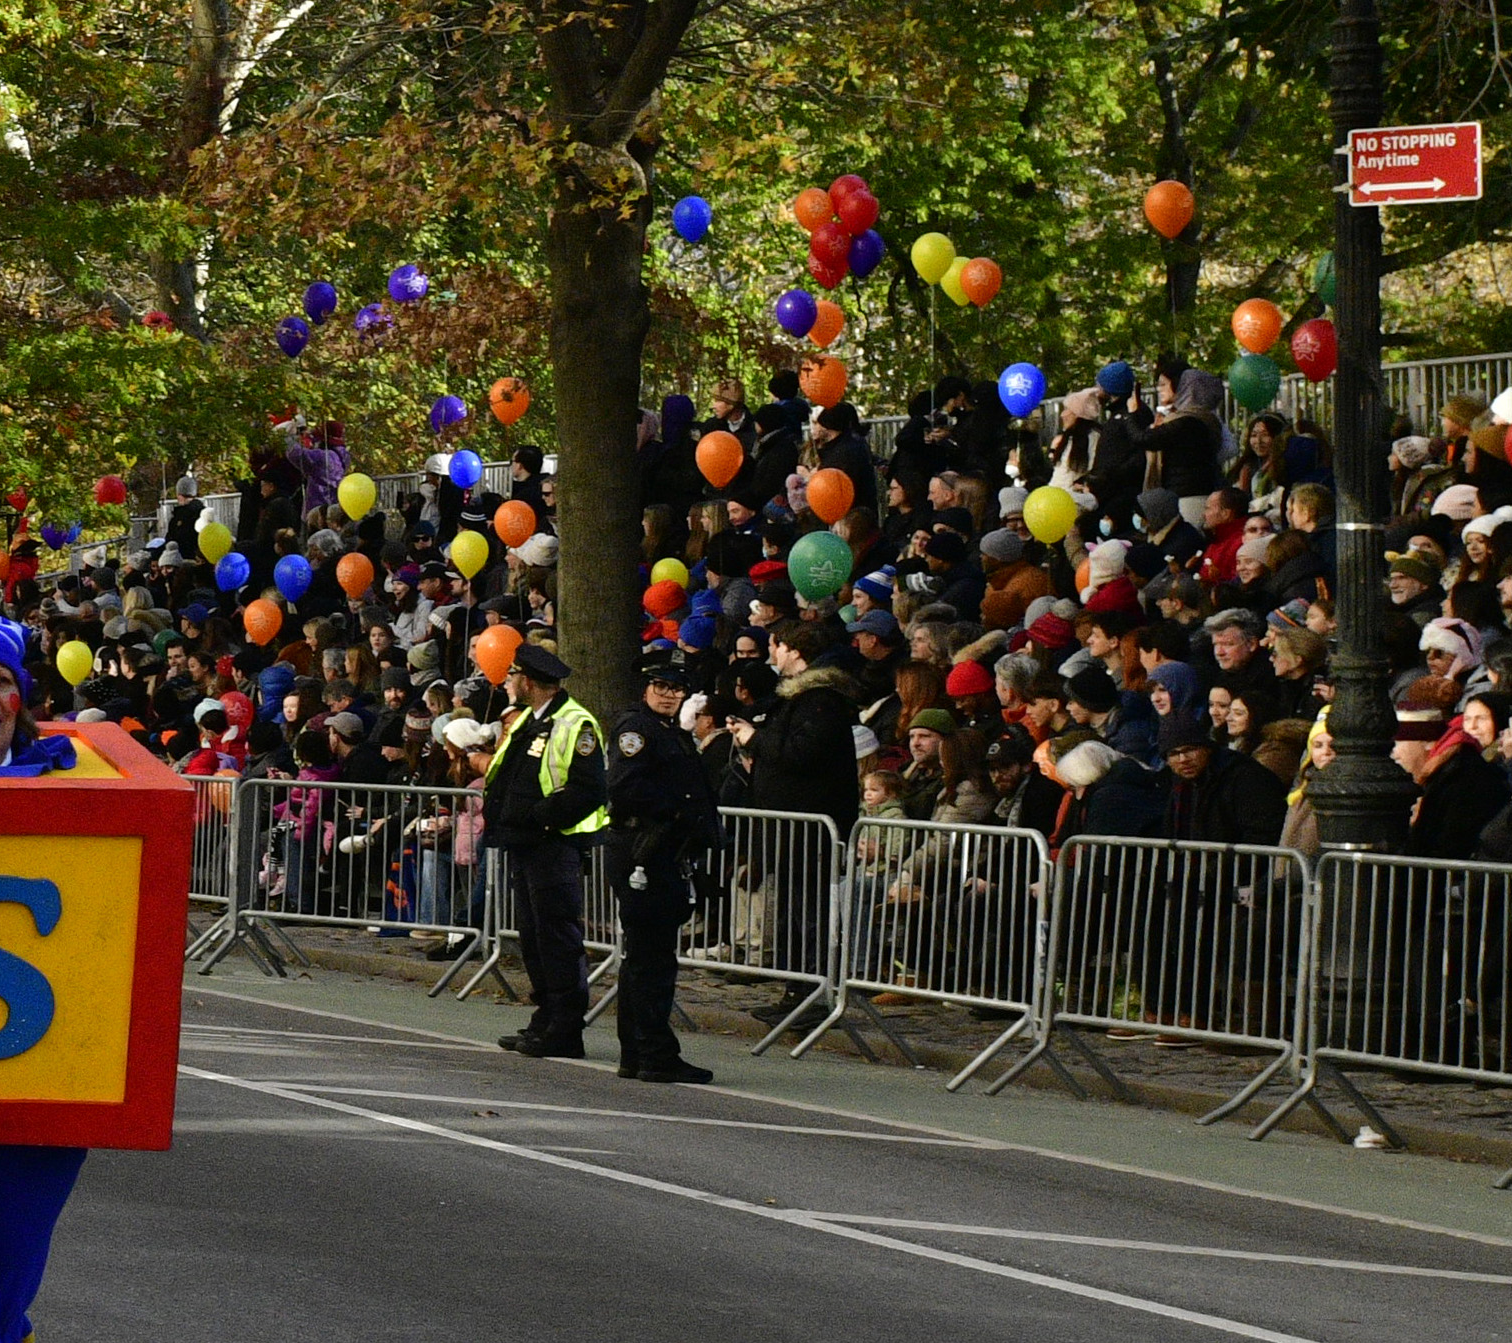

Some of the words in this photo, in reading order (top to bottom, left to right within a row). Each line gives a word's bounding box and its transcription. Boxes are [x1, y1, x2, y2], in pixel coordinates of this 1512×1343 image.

[1356, 138, 1379, 152] NO
[1381, 132, 1457, 151] STOPPING
[1357, 152, 1420, 172] Anytime
